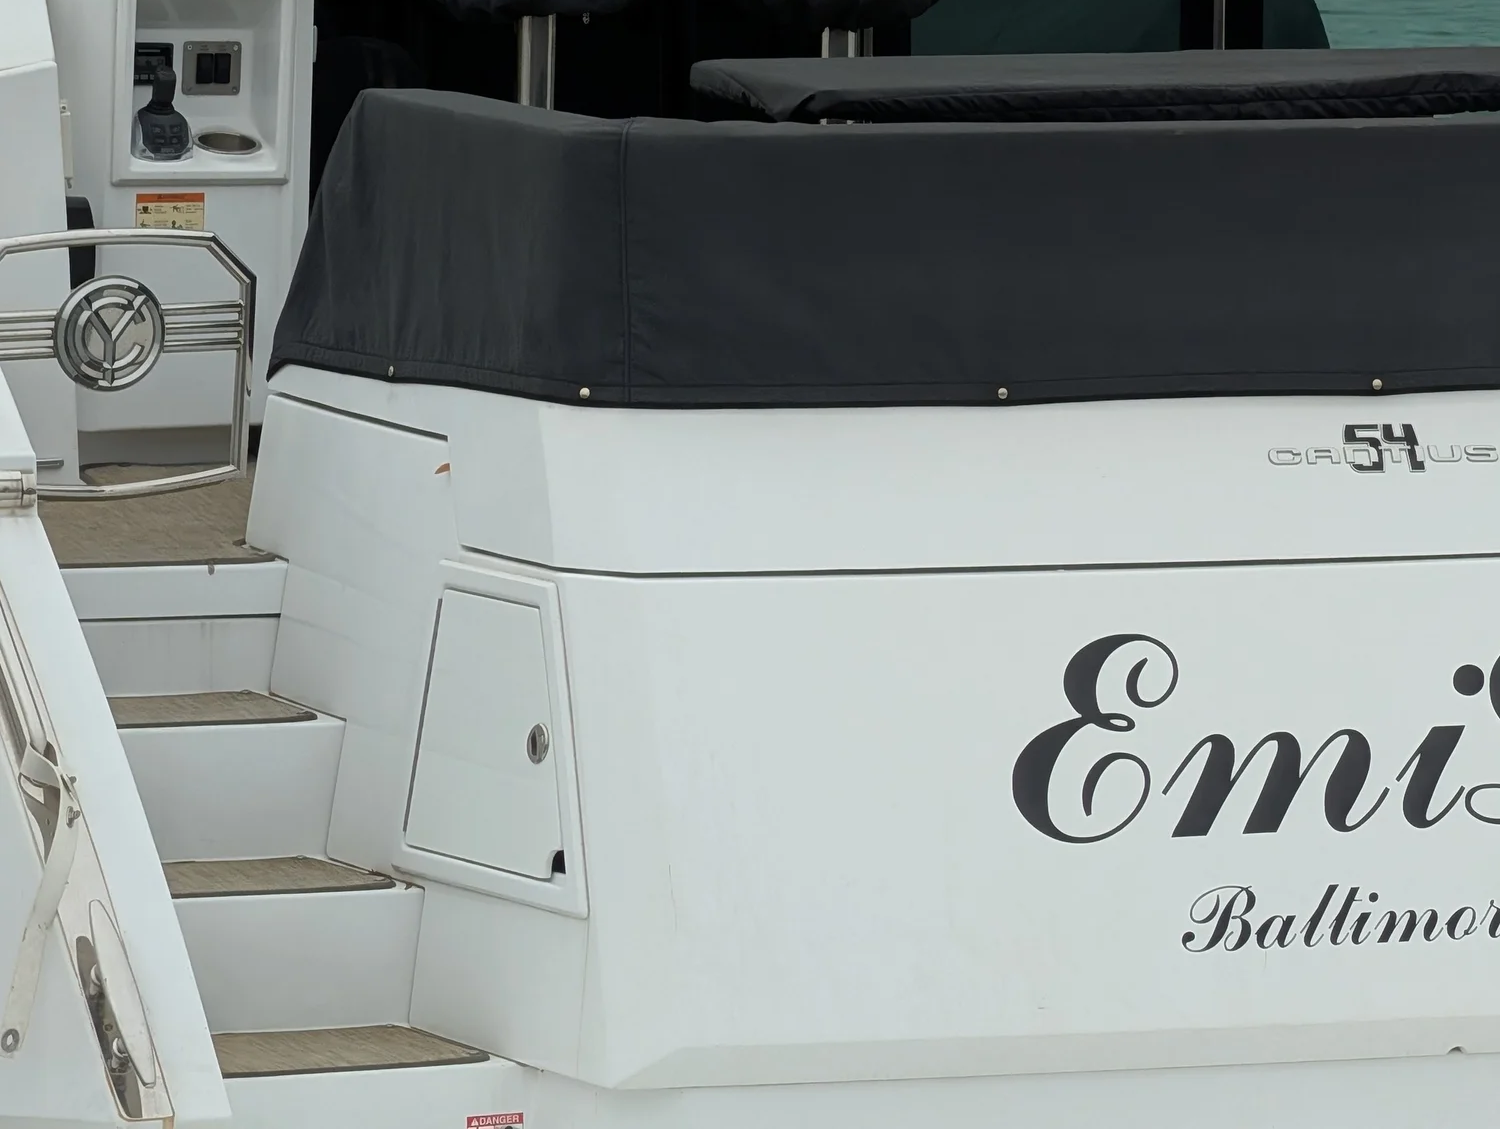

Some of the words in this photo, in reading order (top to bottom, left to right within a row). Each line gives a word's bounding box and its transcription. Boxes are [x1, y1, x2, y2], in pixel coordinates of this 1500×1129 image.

[1267, 443, 1500, 466] CANTIUS
[1342, 422, 1427, 474] 54
[479, 1115, 519, 1125] DANGER
